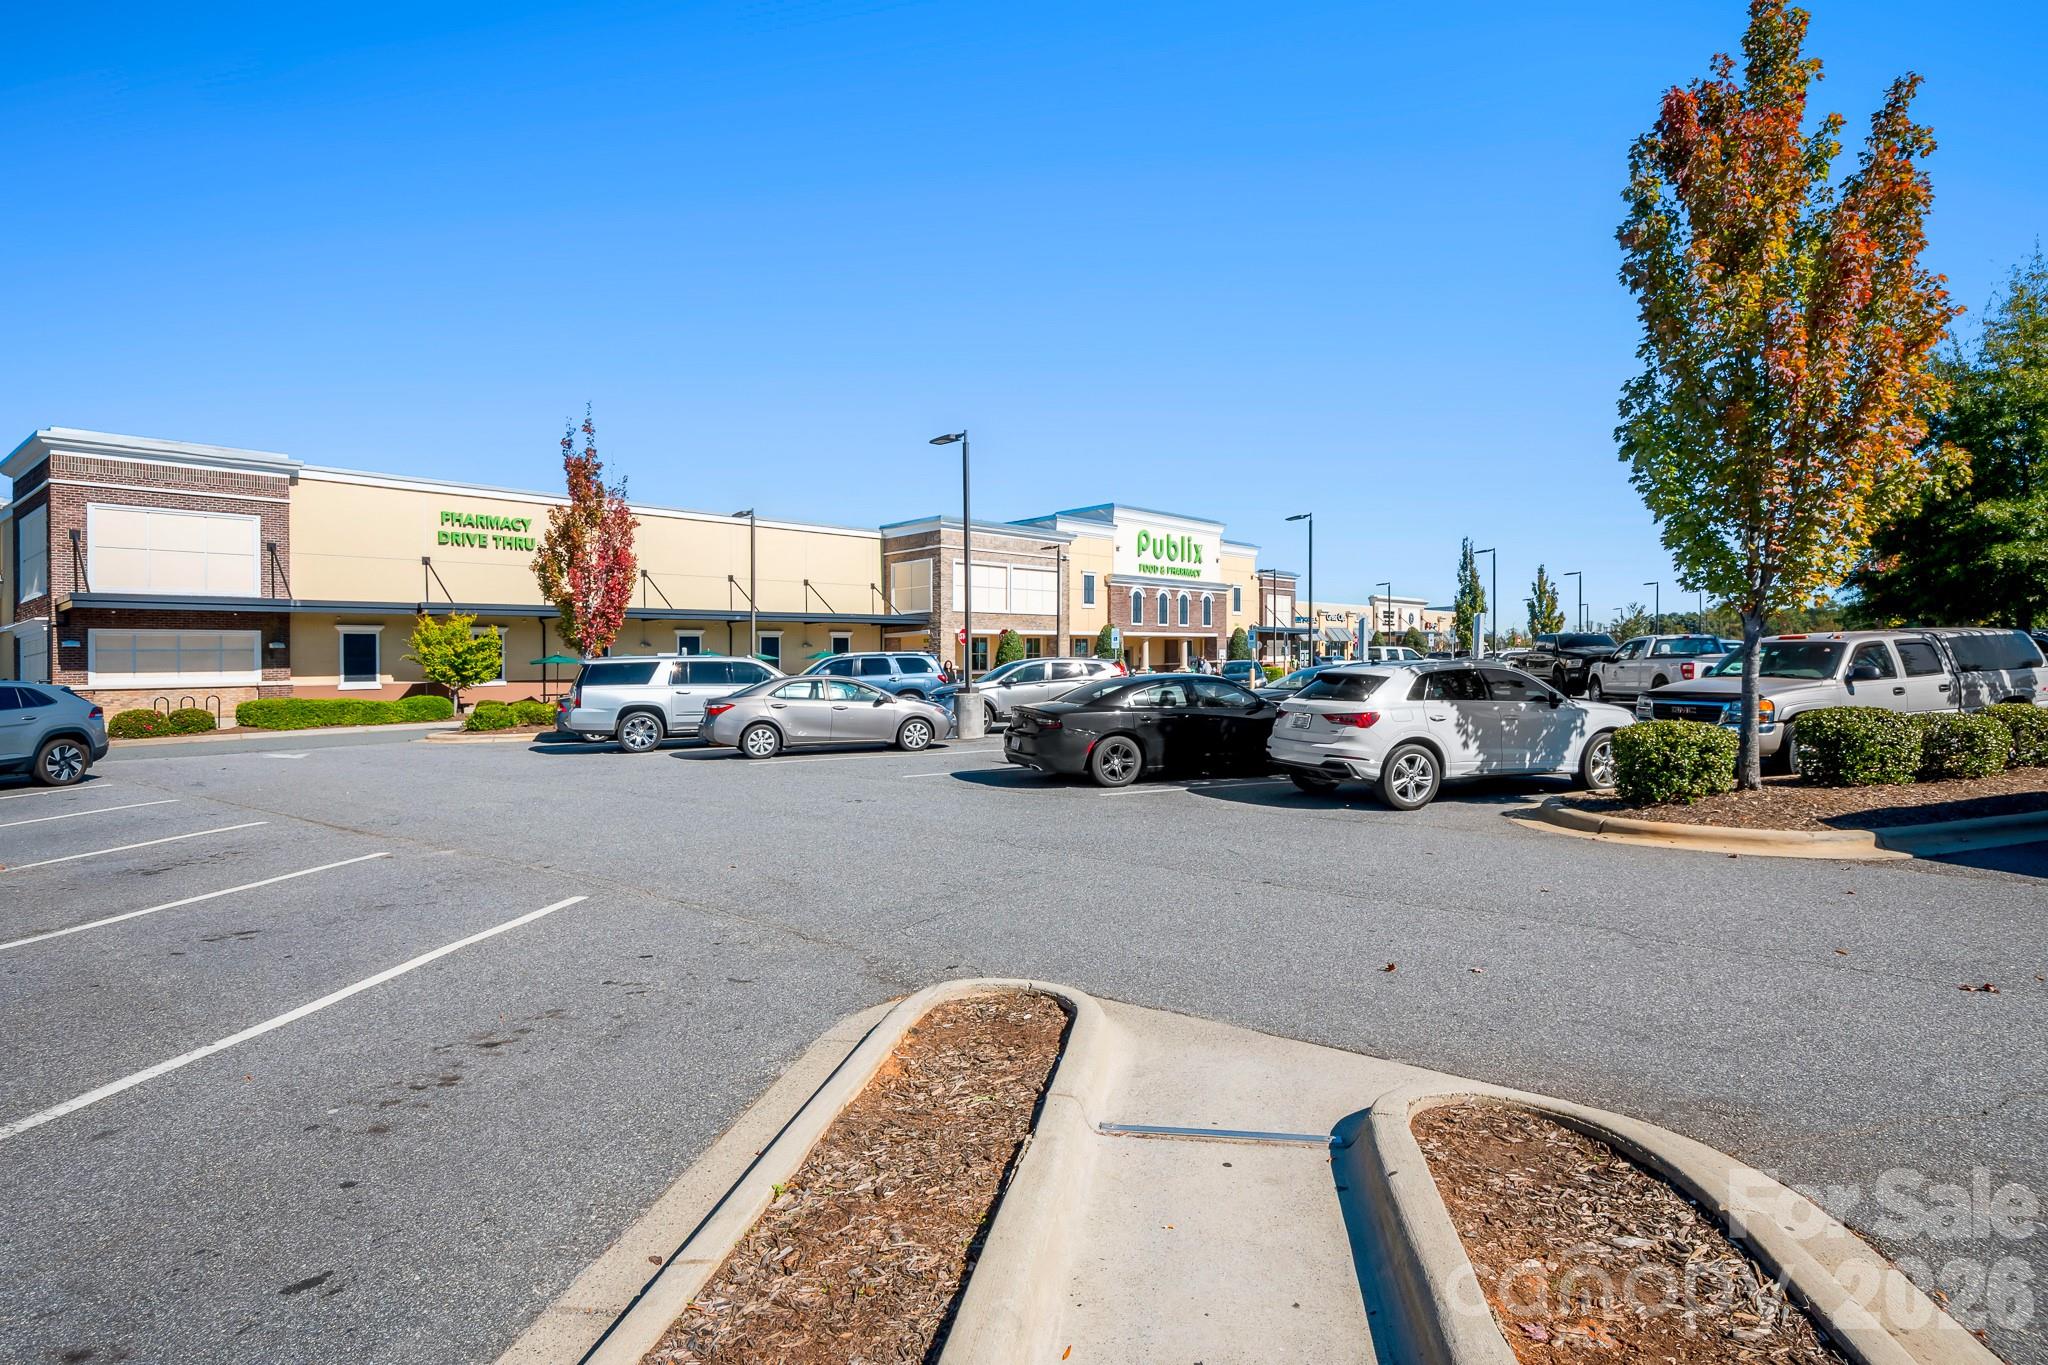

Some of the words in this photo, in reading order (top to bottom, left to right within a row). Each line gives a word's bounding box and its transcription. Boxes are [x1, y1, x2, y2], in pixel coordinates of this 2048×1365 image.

[440, 511, 532, 532] PHARMACY
[437, 531, 488, 548] DRIVE
[492, 535, 535, 552] THRU
[1137, 529, 1203, 564] Publix
[1139, 564, 1158, 574] FOOD
